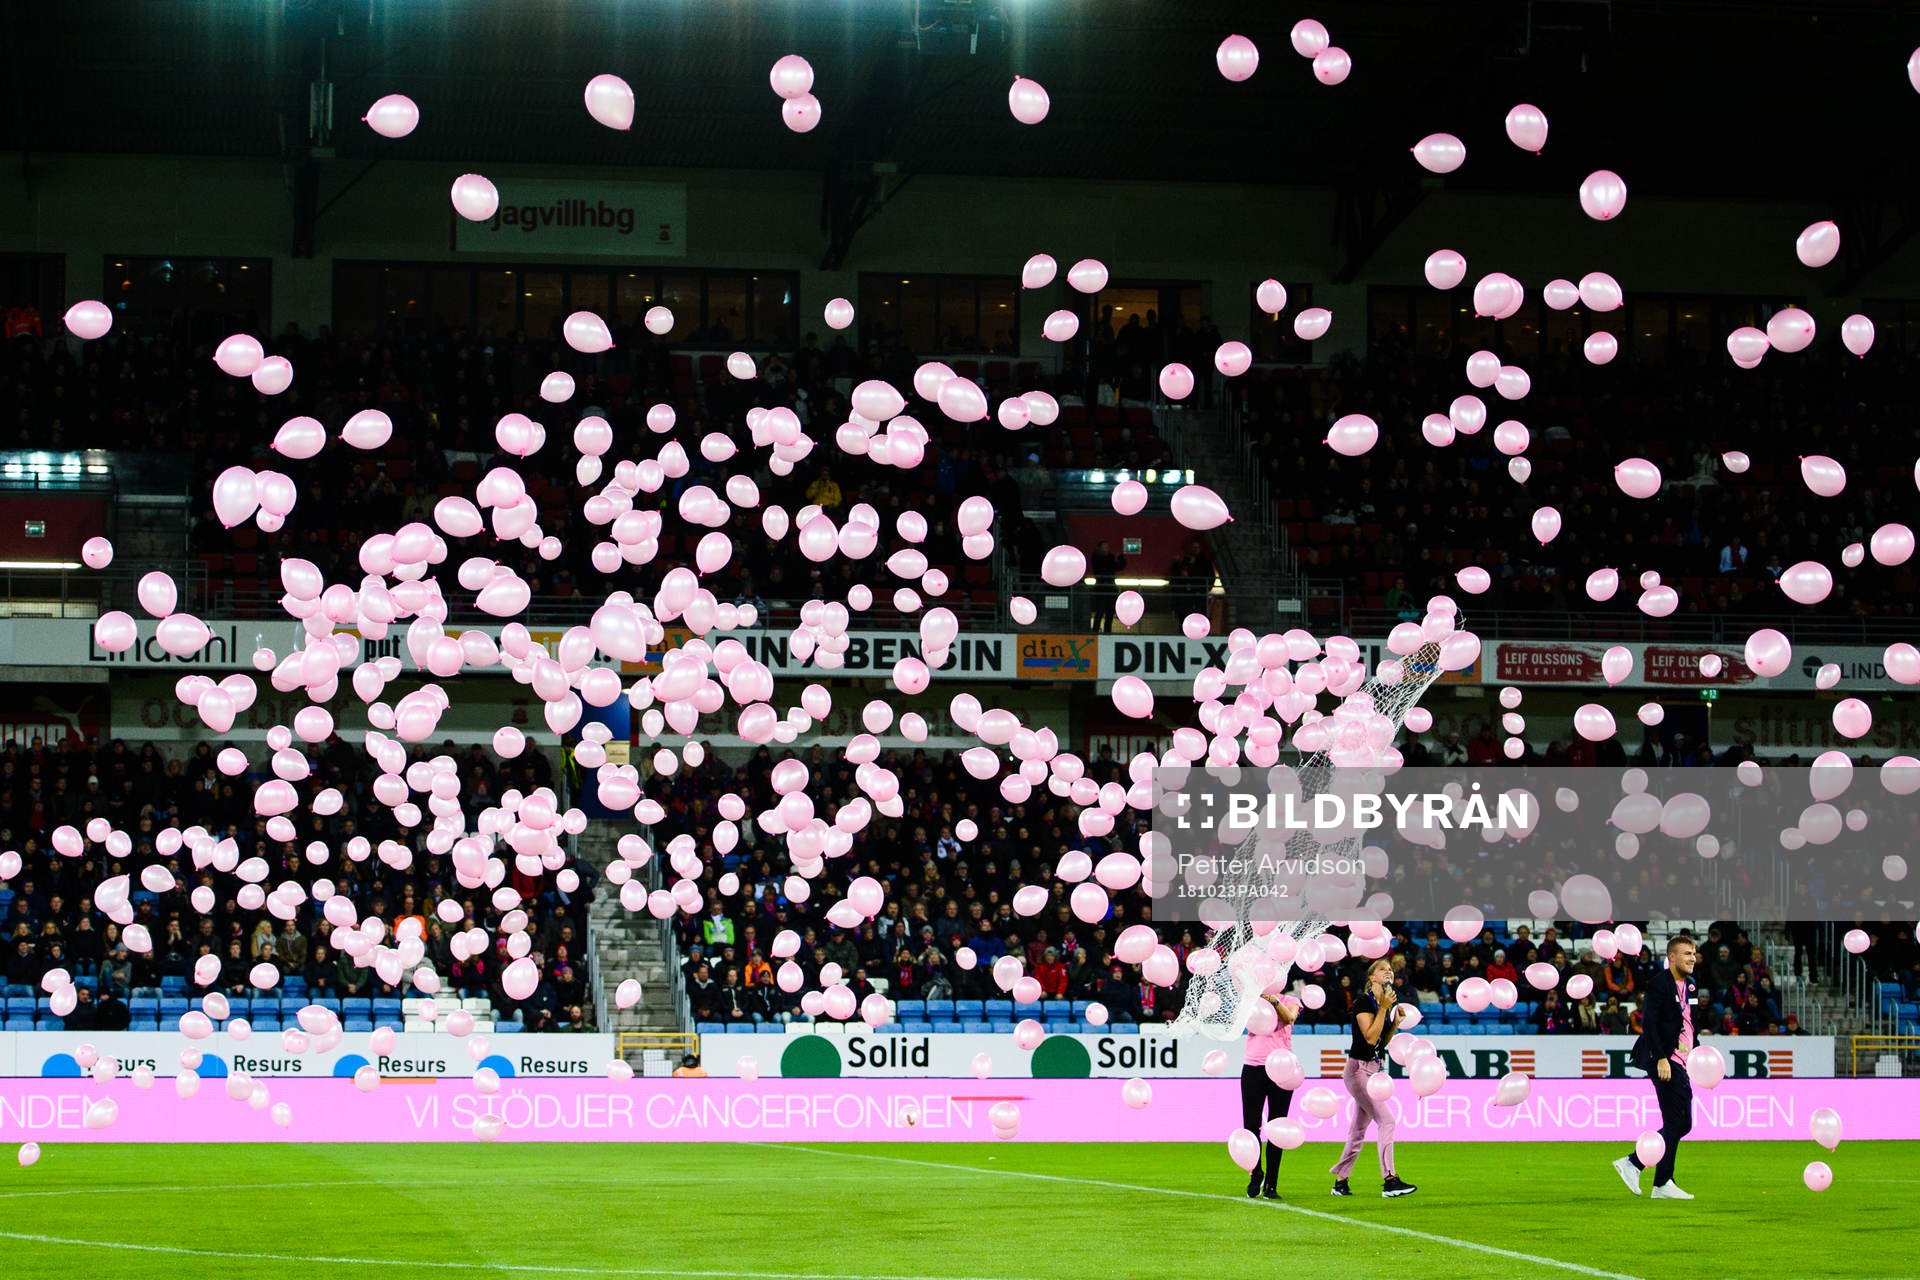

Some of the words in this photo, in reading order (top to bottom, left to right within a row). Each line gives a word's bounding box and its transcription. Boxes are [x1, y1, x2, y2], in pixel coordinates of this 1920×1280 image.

[477, 200, 635, 234] jagvillhbg
[89, 624, 236, 663] Lnhl
[1505, 652, 1528, 665] LEIF
[1531, 653, 1583, 666] OLSSONS
[1652, 655, 1675, 667] LEIF
[1678, 655, 1729, 668] OLSS
[1841, 662, 1892, 680] LIND
[233, 1055, 302, 1072] Resurs
[378, 1055, 446, 1073] Resurs
[520, 1056, 588, 1073] Resurs
[848, 1036, 929, 1068] Solid
[1097, 1037, 1178, 1069] Solid
[406, 1095, 438, 1129] VI
[451, 1088, 634, 1129] STÖDJER
[645, 1093, 973, 1129] CANCERFONDEN
[1483, 1094, 1795, 1129] CANCERFNDEN
